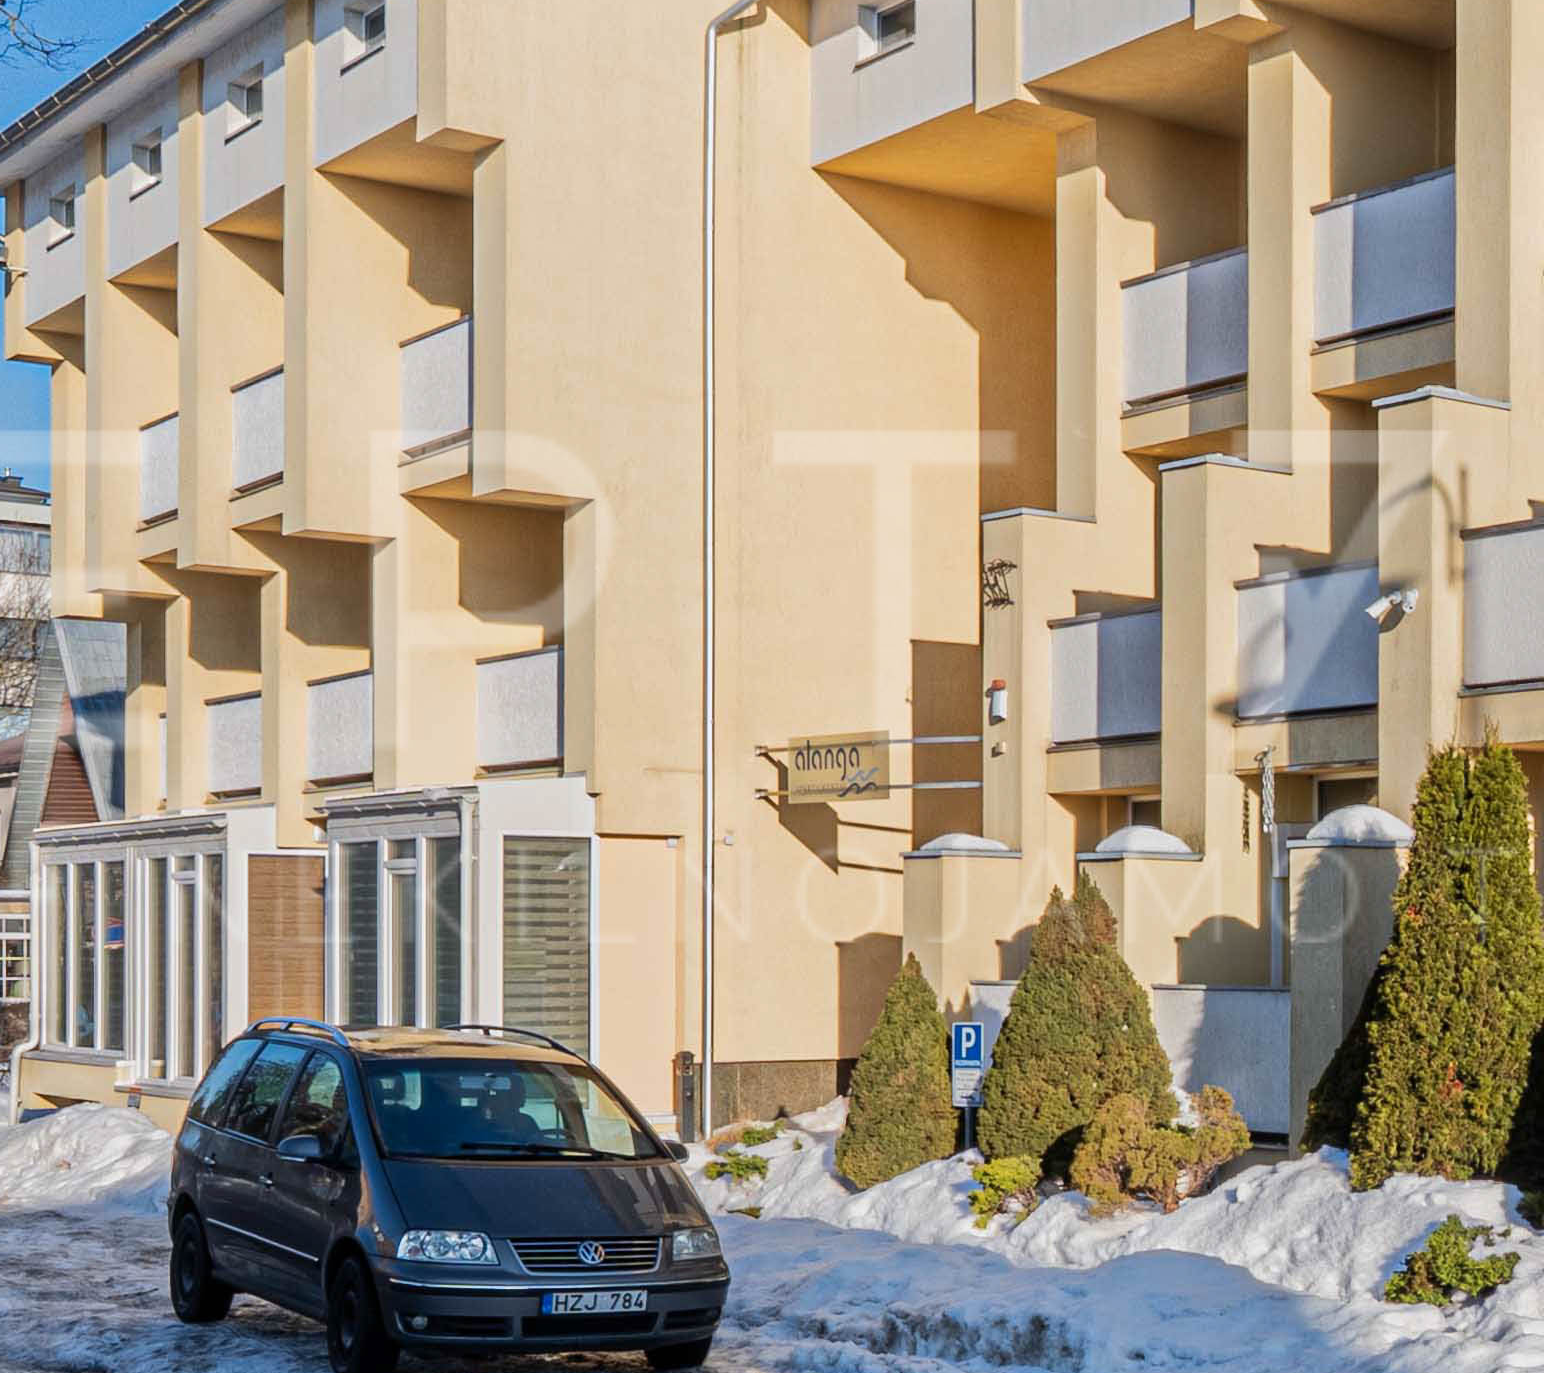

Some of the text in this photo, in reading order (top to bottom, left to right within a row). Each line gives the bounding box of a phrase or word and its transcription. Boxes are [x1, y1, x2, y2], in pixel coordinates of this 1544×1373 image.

[795, 740, 860, 780] alanga
[961, 1027, 976, 1058] P
[555, 1292, 644, 1312] HZJ 784
